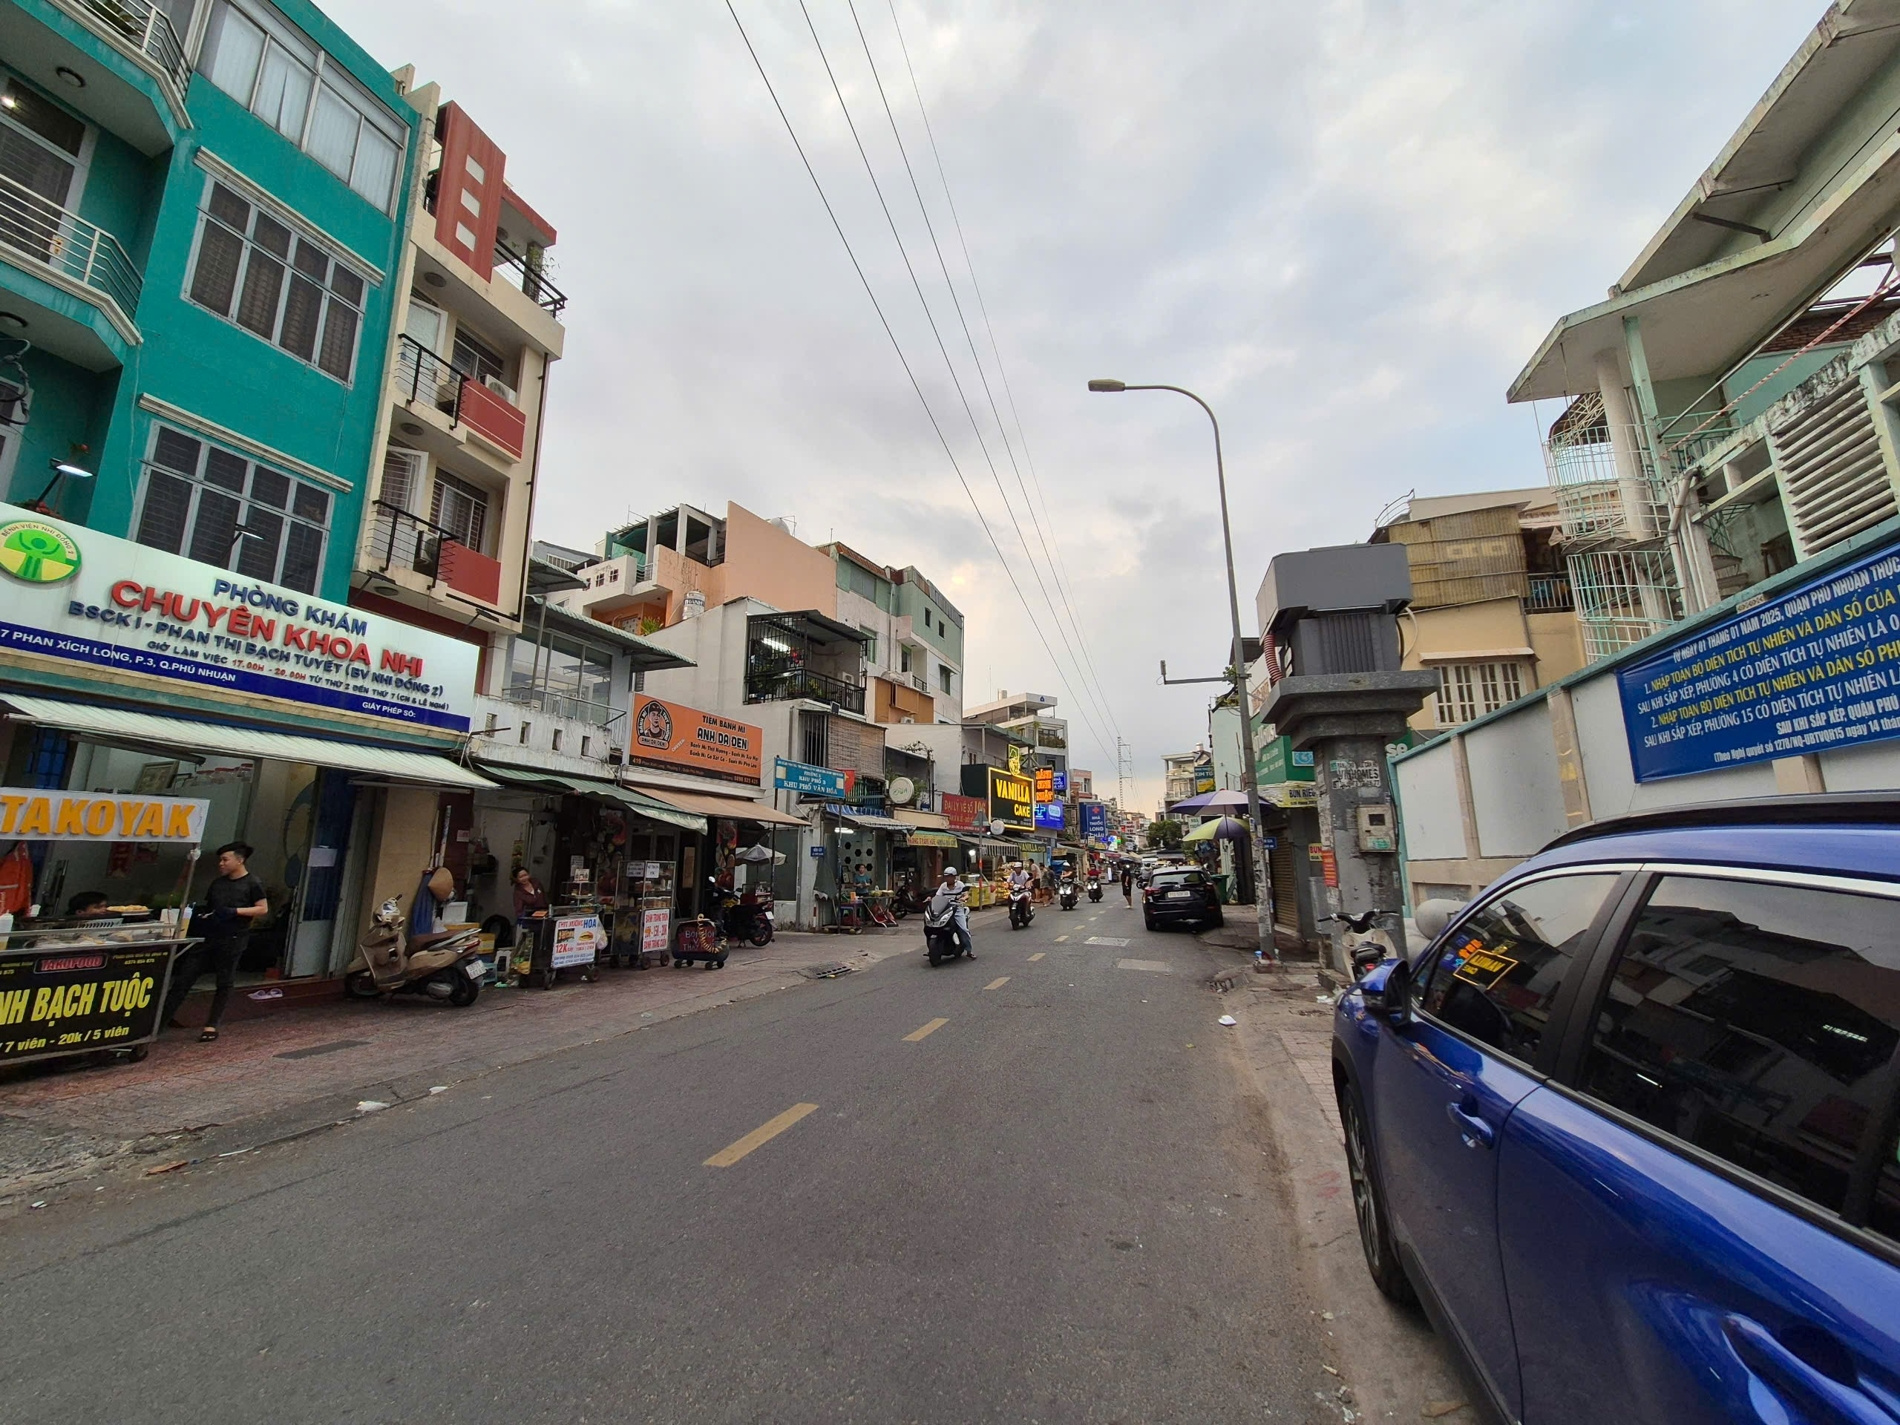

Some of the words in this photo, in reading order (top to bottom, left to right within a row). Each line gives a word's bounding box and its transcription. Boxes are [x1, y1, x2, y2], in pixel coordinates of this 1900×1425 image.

[214, 578, 299, 617] PHÒNG
[306, 605, 367, 637] KHÁM
[1730, 625, 1740, 640] 01
[1760, 607, 1785, 627] 2025,
[1784, 594, 1811, 616] QUẬN
[1831, 570, 1871, 598] NHUẬN
[1869, 556, 1900, 582] THỰC
[111, 580, 276, 643] CHUYÊN
[284, 623, 371, 666] KHOA
[381, 648, 424, 678] NHI
[1651, 673, 1671, 692] NHẬP
[1670, 664, 1691, 685] TOÀN
[1692, 658, 1704, 678] BỘ
[1705, 651, 1726, 672] DIỆN
[1725, 645, 1747, 665] TÍCH
[1747, 637, 1761, 657] TỰ
[1762, 626, 1797, 651] NHIÊN
[1796, 616, 1814, 638] VÀ
[1814, 608, 1843, 632] DÂN
[1843, 592, 1863, 621] SỐ
[1865, 587, 1896, 613] CỦA
[12, 631, 54, 647] PHAN
[57, 639, 90, 654] XÍCH
[93, 647, 132, 664] LONG,
[135, 655, 157, 668] P.3,
[159, 660, 196, 675] Q.PHÚ
[197, 668, 236, 682] NHUẬN
[147, 640, 171, 653] GIỜ
[173, 644, 200, 659] LÀM
[203, 652, 228, 665] VIỆC
[155, 621, 210, 645] PHAN
[214, 635, 242, 655] THỊ
[245, 641, 290, 663] BẠCH
[294, 653, 343, 674] TUYẾT
[371, 671, 393, 686] NHI
[1637, 702, 1651, 715] SAU
[1650, 695, 1665, 711] KHI
[1695, 671, 1732, 696] PHƯỜNG
[1732, 669, 1739, 683] 4
[1740, 660, 1754, 681] CÓ
[1755, 654, 1780, 676] DIỆN
[1780, 645, 1807, 667] TÍCH
[1807, 638, 1825, 660] TỰ
[1825, 624, 1867, 653] NHIÊN
[1868, 614, 1889, 639] LÀ
[1650, 716, 1658, 729] 2.
[1658, 707, 1678, 727] NHẬP
[1678, 701, 1700, 721] TOÀN
[1700, 695, 1713, 715] BỘ
[1713, 690, 1735, 711] DIỆN
[1734, 685, 1757, 704] TÍCH
[1756, 678, 1771, 699] TỰ
[1772, 668, 1807, 693] NHIÊN
[1807, 661, 1825, 682] VÀ
[1826, 654, 1855, 678] DÂN
[1855, 641, 1876, 669] SỐ
[362, 701, 382, 713] GIẤY
[382, 705, 403, 716] PHÉP
[1644, 735, 1658, 748] SAU
[1658, 730, 1672, 745] KHI
[1703, 710, 1741, 733] PHƯỜNG
[1740, 708, 1754, 724] 15
[1755, 699, 1770, 720] CÓ
[1771, 694, 1797, 716] DIỆN
[1797, 688, 1825, 709] TÍCH
[1825, 681, 1843, 704] TỰ
[1844, 670, 1888, 697] NHIÊN
[1776, 719, 1793, 735] SAU
[1792, 715, 1810, 732] KHI
[1847, 699, 1876, 719] QUẬN
[697, 726, 716, 744] ANH
[717, 731, 731, 747] DA
[1765, 739, 1774, 753] số
[1845, 723, 1868, 738] ngày
[1868, 719, 1880, 733] 14
[783, 780, 798, 788] KHU
[799, 782, 812, 791] PHỐ
[996, 778, 1031, 804] VANILLA
[0, 795, 196, 838] TAKOYAK
[1014, 803, 1031, 818] CAKE
[583, 918, 597, 929] HOA
[31, 982, 98, 1027] BẠCH
[100, 971, 154, 1018] TUỘC
[5, 1041, 15, 1053] 7
[17, 1036, 47, 1051] viên
[58, 1032, 83, 1046] 20k
[93, 1028, 102, 1040] 5
[104, 1025, 130, 1039] viên
